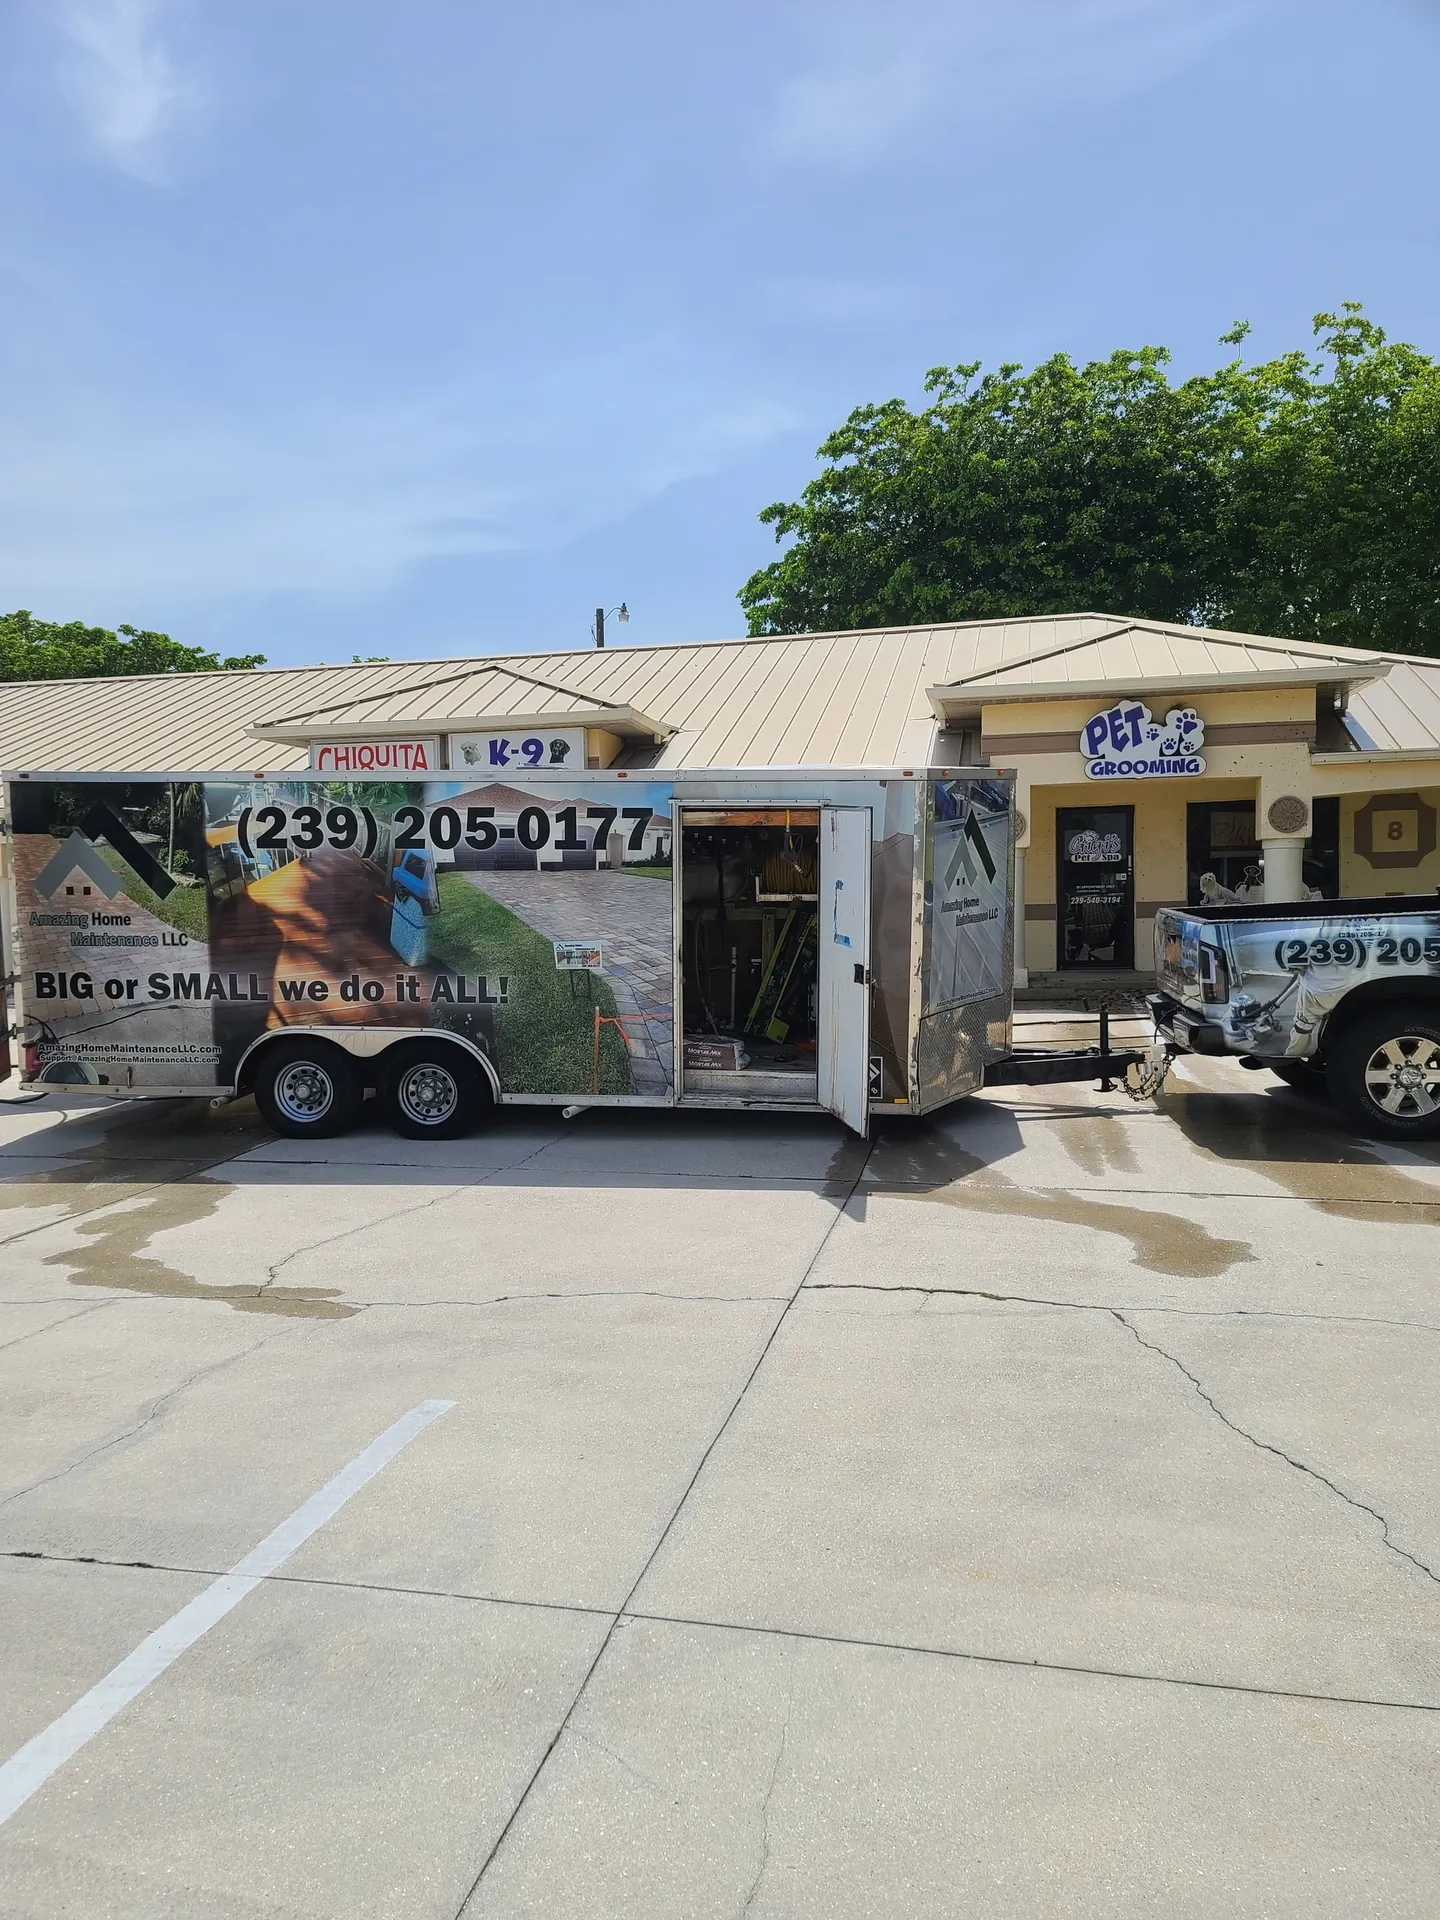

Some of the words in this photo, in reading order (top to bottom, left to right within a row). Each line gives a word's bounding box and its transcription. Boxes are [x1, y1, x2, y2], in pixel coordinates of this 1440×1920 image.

[1085, 705, 1145, 756] PET
[318, 743, 429, 771] CHIQUITA
[488, 738, 545, 767] K-9
[1090, 758, 1200, 776] GROOMING
[237, 806, 378, 860] (239)
[393, 806, 655, 851] 205-0177
[1387, 821, 1403, 841] 8
[1074, 853, 1090, 862] Pet
[1101, 853, 1119, 862] Spa
[940, 899, 964, 913] Amazing
[963, 897, 980, 909] Home
[988, 907, 999, 920] LLC
[29, 911, 89, 929] Amazing
[91, 912, 132, 926] Home
[70, 932, 160, 947] Maintenance
[162, 932, 189, 947] LLC
[1275, 939, 1367, 969] (239)
[35, 971, 94, 999] BIG
[104, 978, 139, 1000] or
[147, 972, 269, 1001] SMALL
[278, 979, 329, 1002] we
[340, 974, 385, 1002] do
[395, 973, 421, 1003] it
[431, 975, 509, 1004] ALL!
[38, 1043, 222, 1055] AmazingHomeMaintenanceLLC.com
[40, 1054, 219, 1063] Support@AmazingHomeMaintenanceLLC.com
